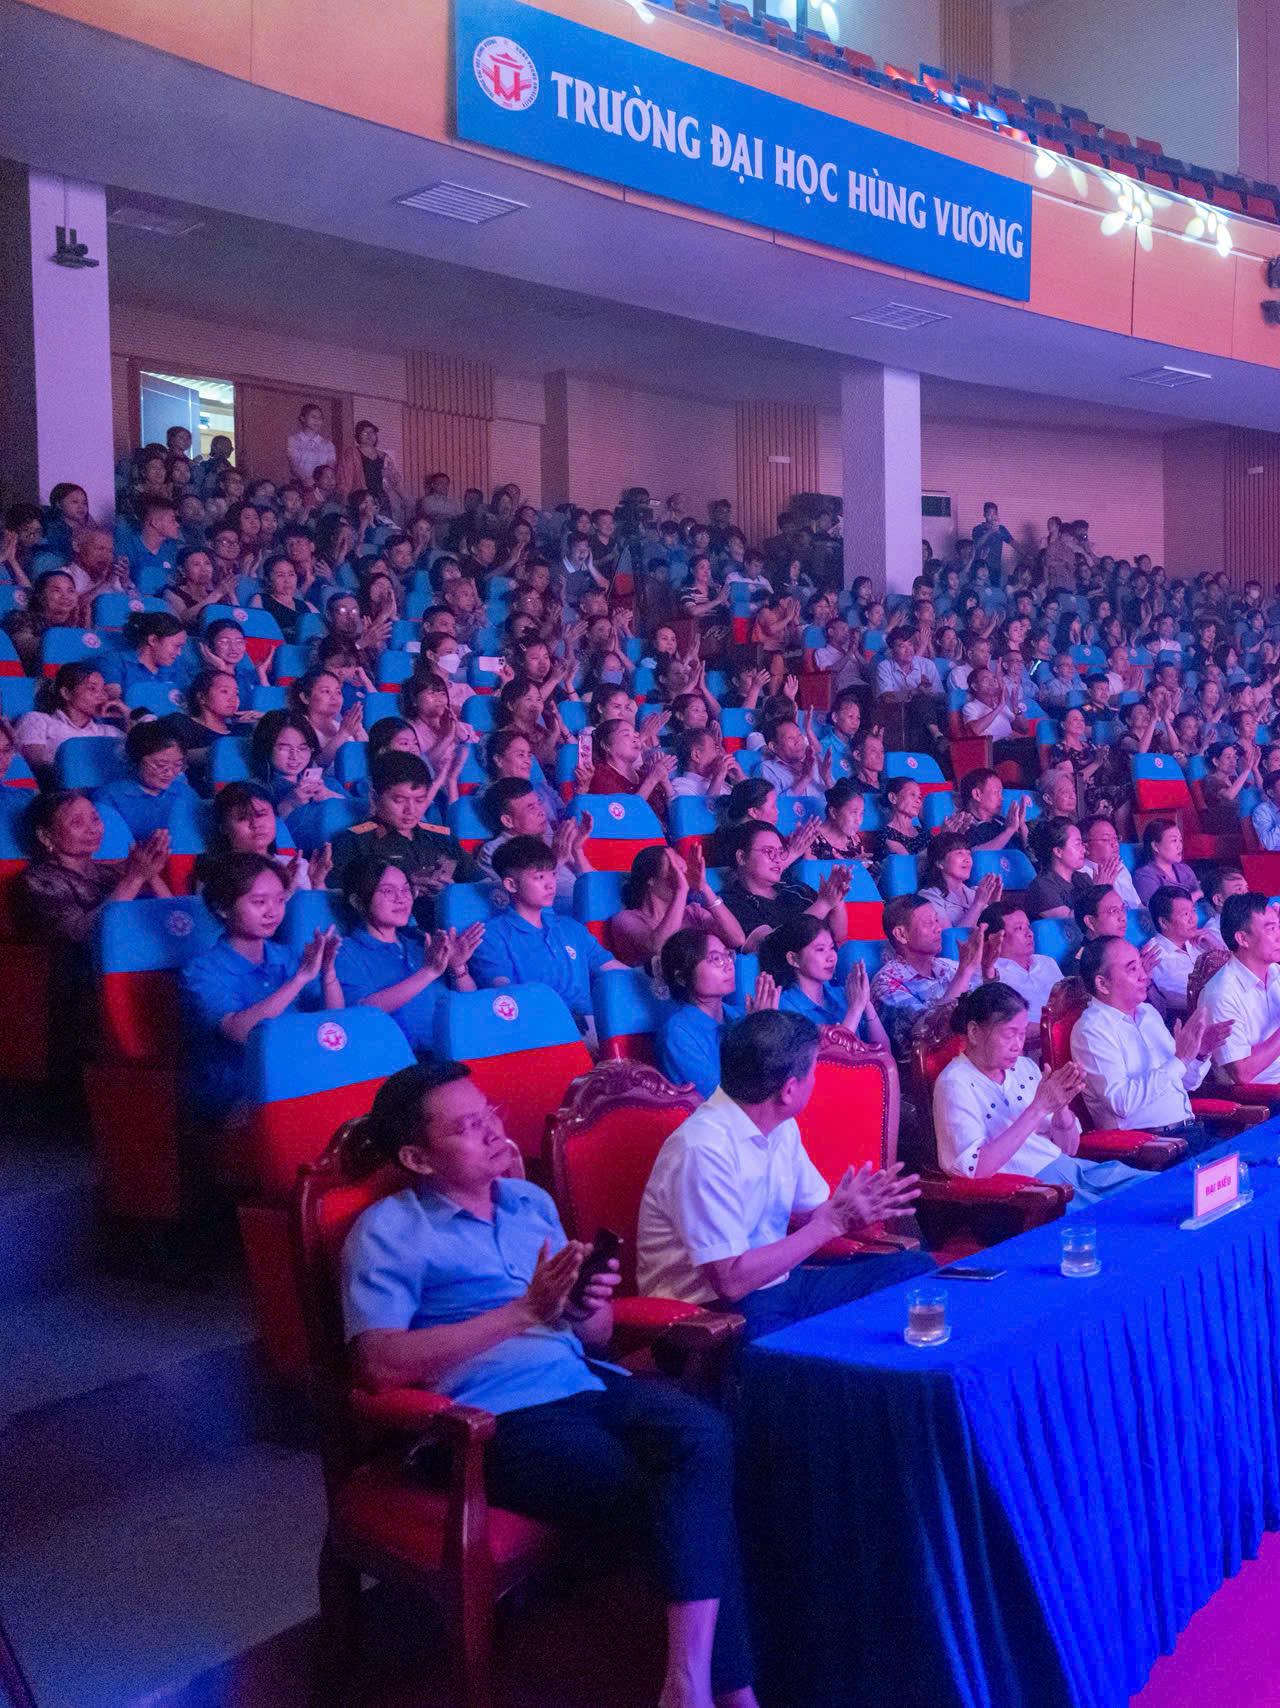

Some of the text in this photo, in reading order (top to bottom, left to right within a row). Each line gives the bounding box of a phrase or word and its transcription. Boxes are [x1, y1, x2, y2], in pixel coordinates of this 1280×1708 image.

[550, 70, 1024, 259] TRƯỜNG ĐẠI HỌC HÙNG VƯƠNG
